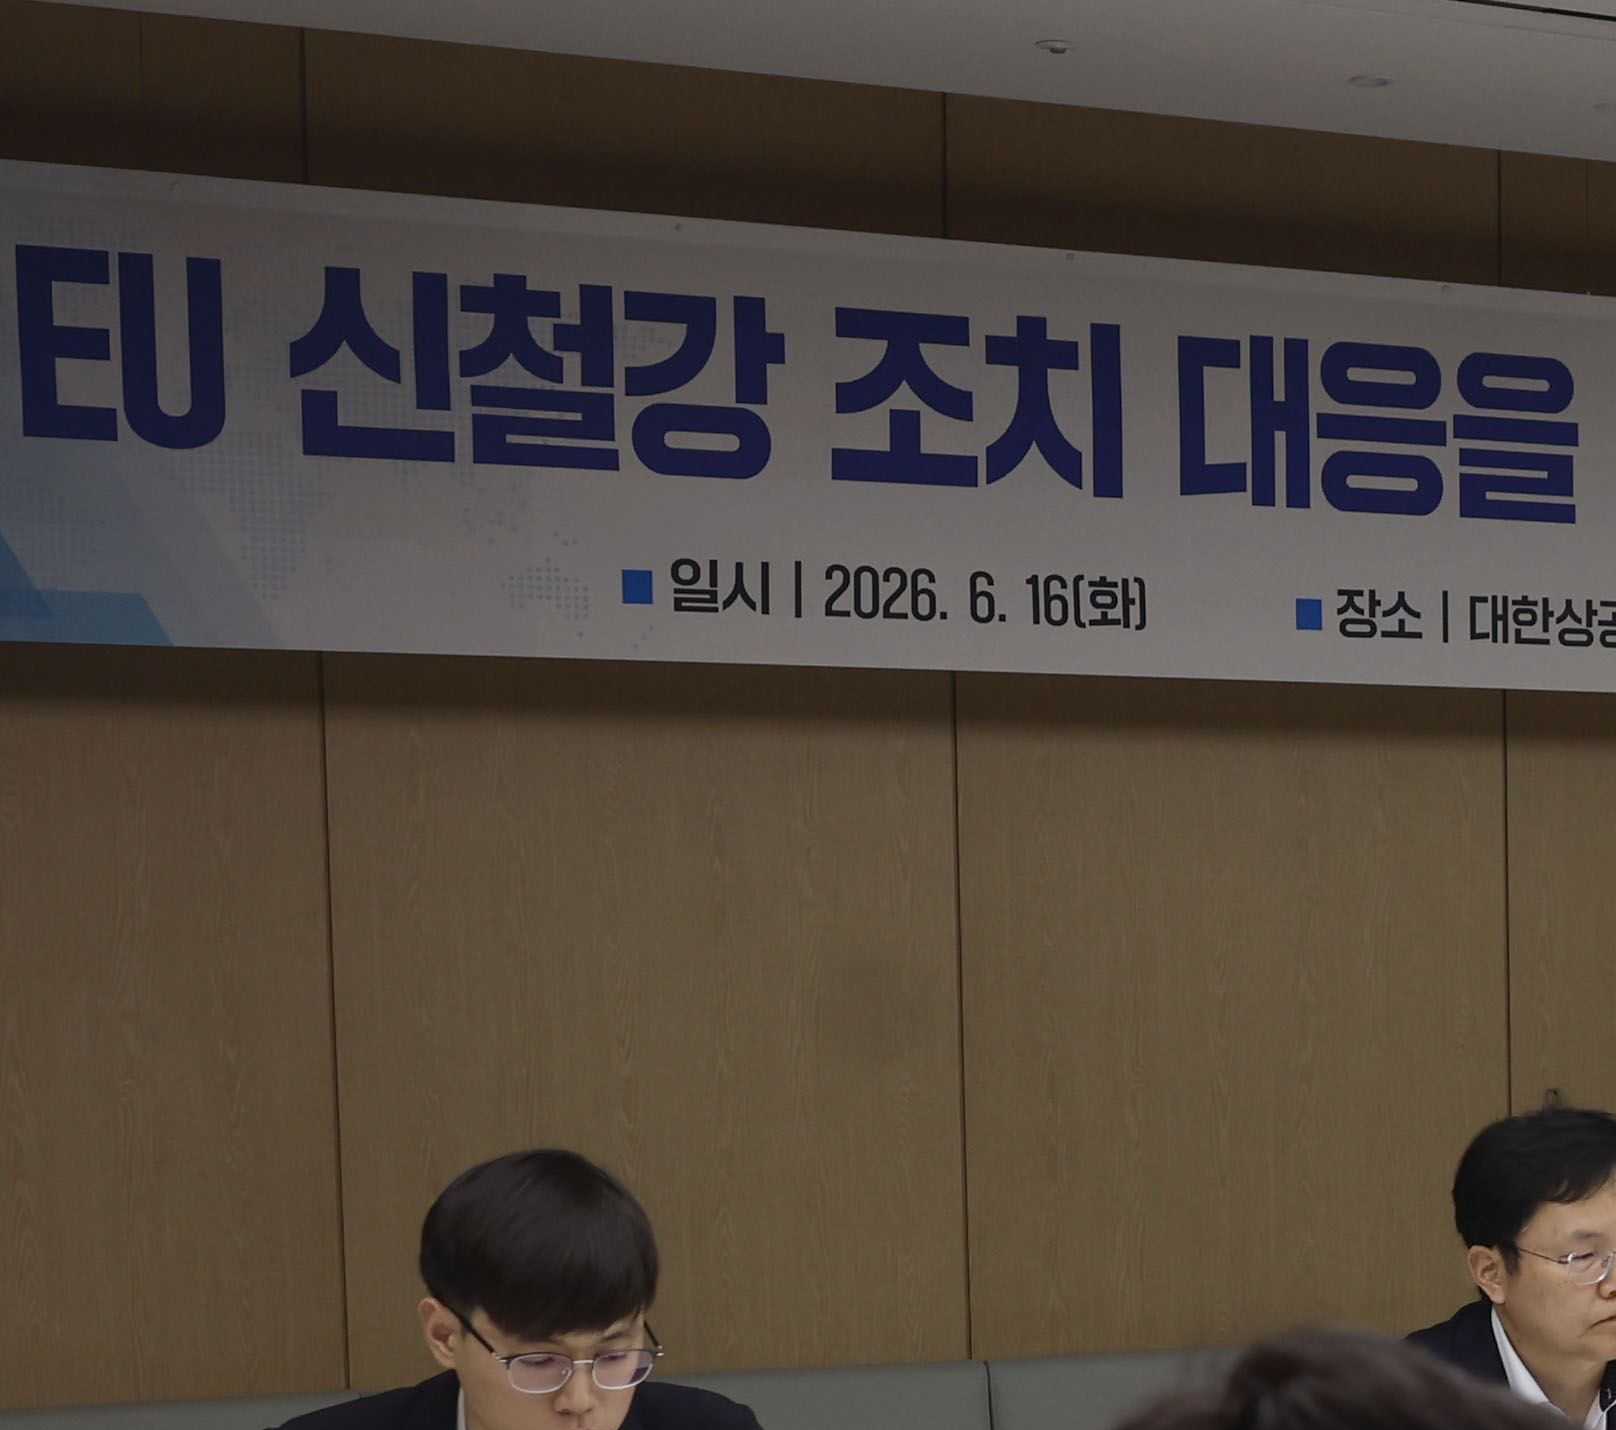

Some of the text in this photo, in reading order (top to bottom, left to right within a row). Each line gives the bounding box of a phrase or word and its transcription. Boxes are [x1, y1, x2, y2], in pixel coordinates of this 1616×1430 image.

[18, 261, 225, 447] EU
[291, 269, 784, 478] 신철강
[832, 309, 1123, 497] 조치
[1179, 335, 1578, 524] 대응을
[670, 557, 1147, 631] 일시 2026. 6. 16(화)
[1336, 588, 1423, 640] 장소
